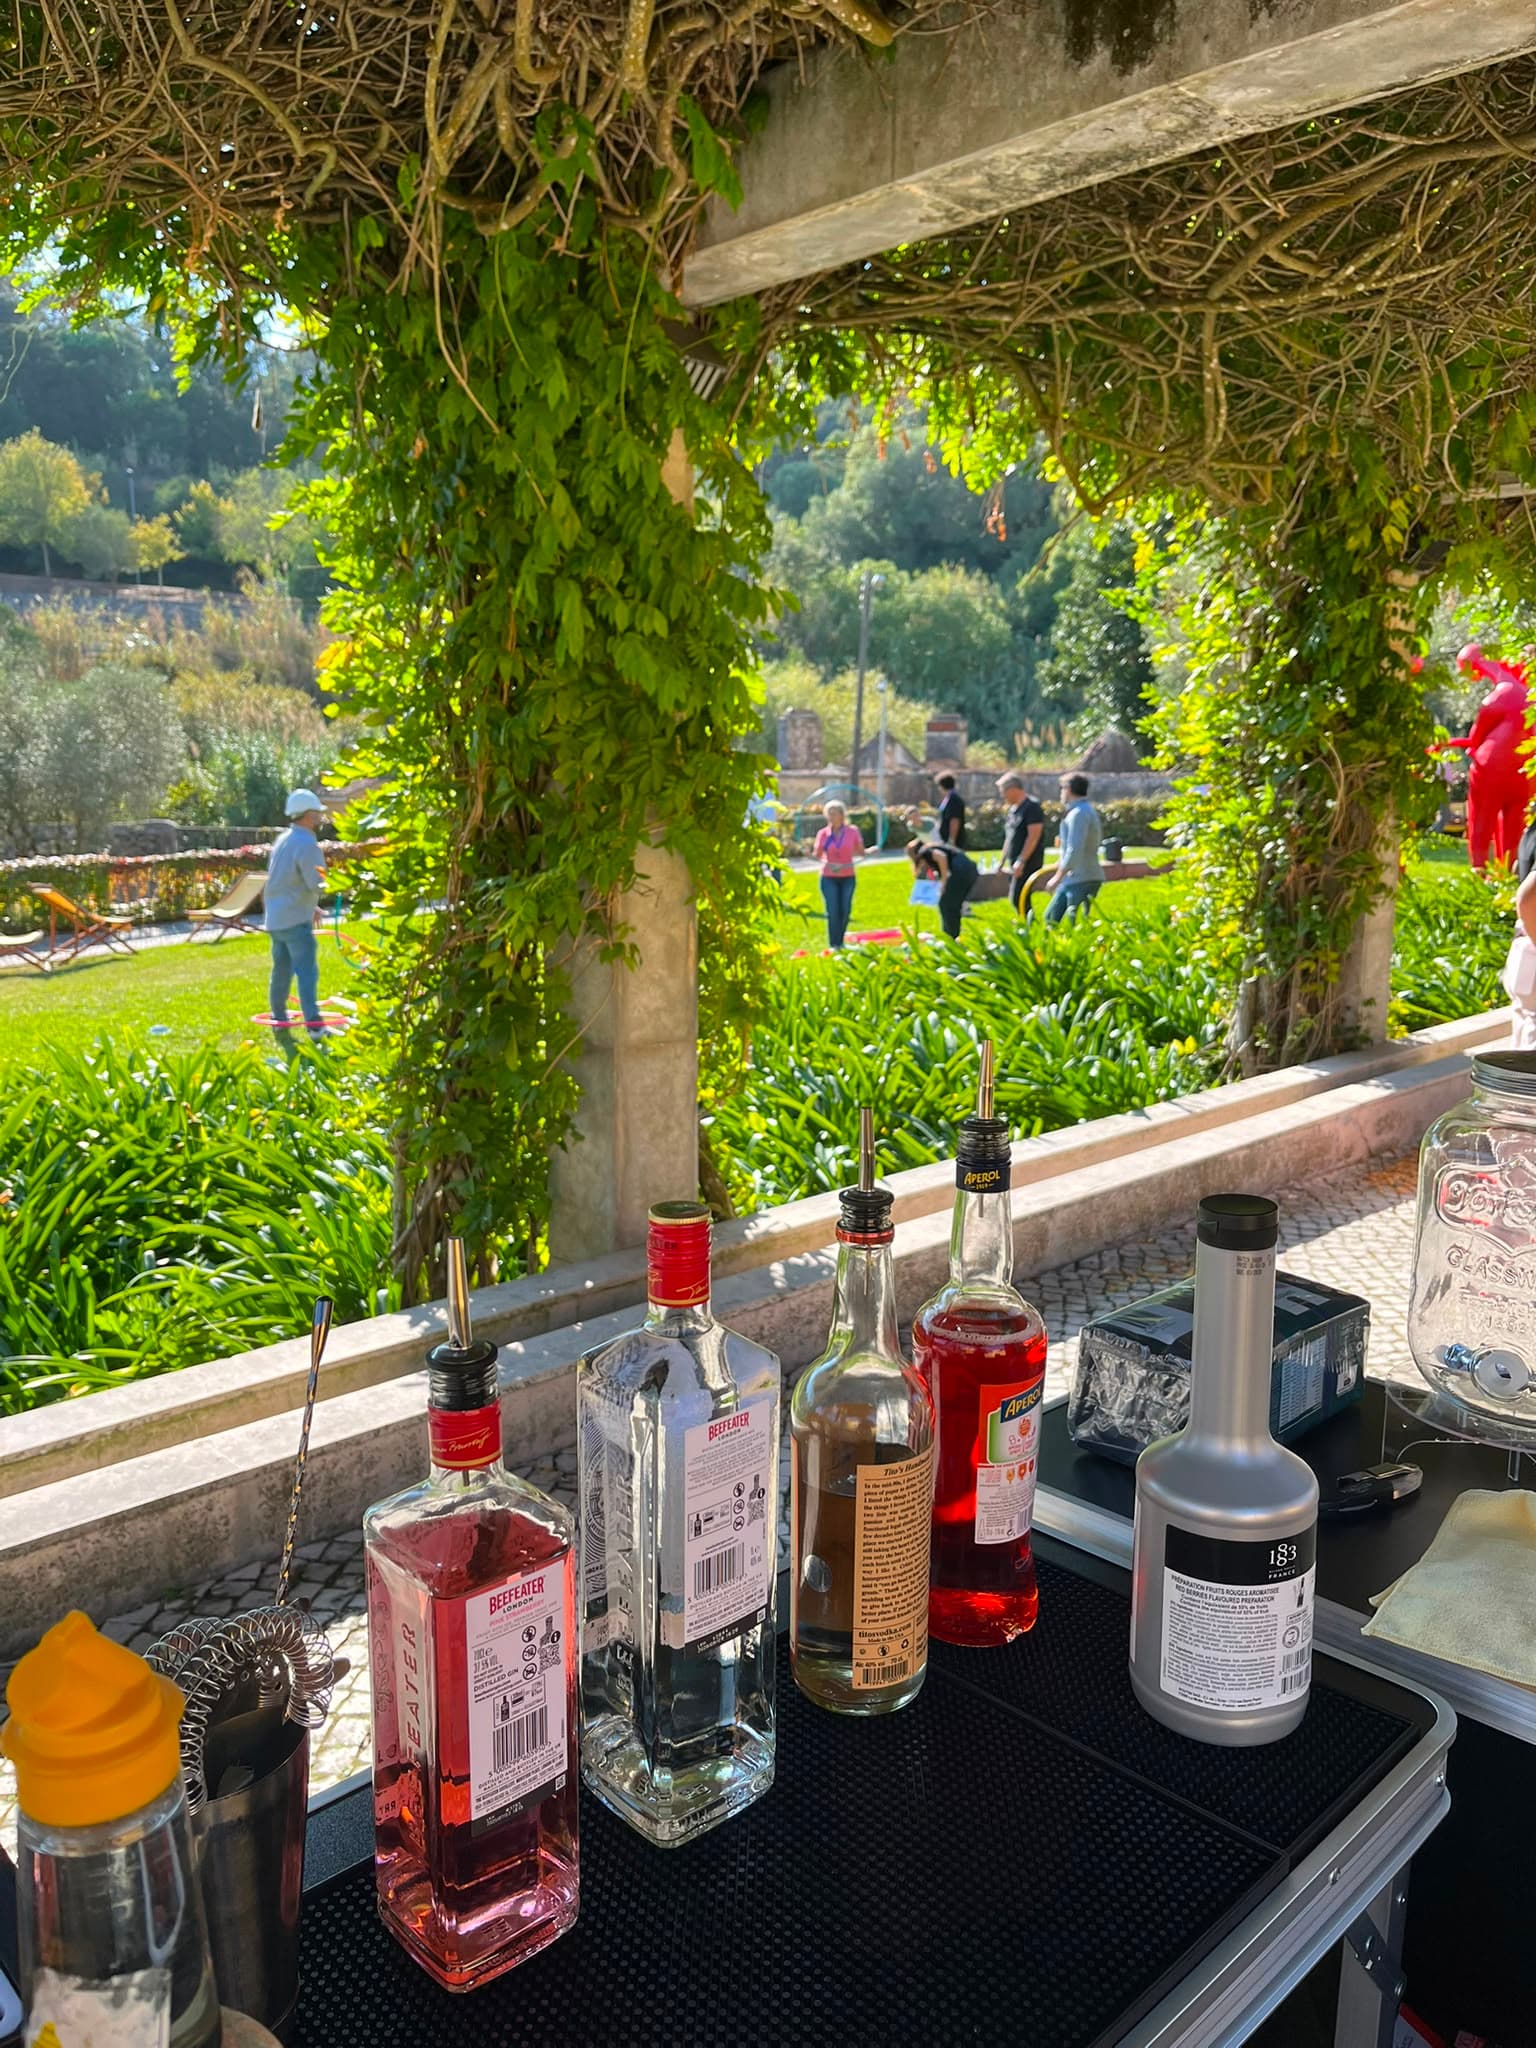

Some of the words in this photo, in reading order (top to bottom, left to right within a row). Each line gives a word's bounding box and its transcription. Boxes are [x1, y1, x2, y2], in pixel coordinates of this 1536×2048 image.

[964, 1170, 1001, 1185] APEROL
[709, 1411, 749, 1442] BEEFEATER
[718, 1428, 741, 1441] LONDON
[1269, 1543, 1297, 1567] 1883
[1268, 1569, 1296, 1580] FRANCE
[489, 1576, 544, 1616] BEEFEATER
[1175, 1583, 1186, 1594] RED
[1186, 1588, 1208, 1600] BERRIES
[1208, 1593, 1240, 1604] FLAVOURED
[1240, 1595, 1275, 1604] PREPARATION
[1205, 1586, 1225, 1595] FRUITS
[1226, 1588, 1248, 1597] ROUGES
[502, 1597, 533, 1614] LONDON
[859, 1622, 911, 1638] titosvodka.com
[474, 1673, 506, 1693] DISTILLED
[507, 1667, 519, 1677] GIN
